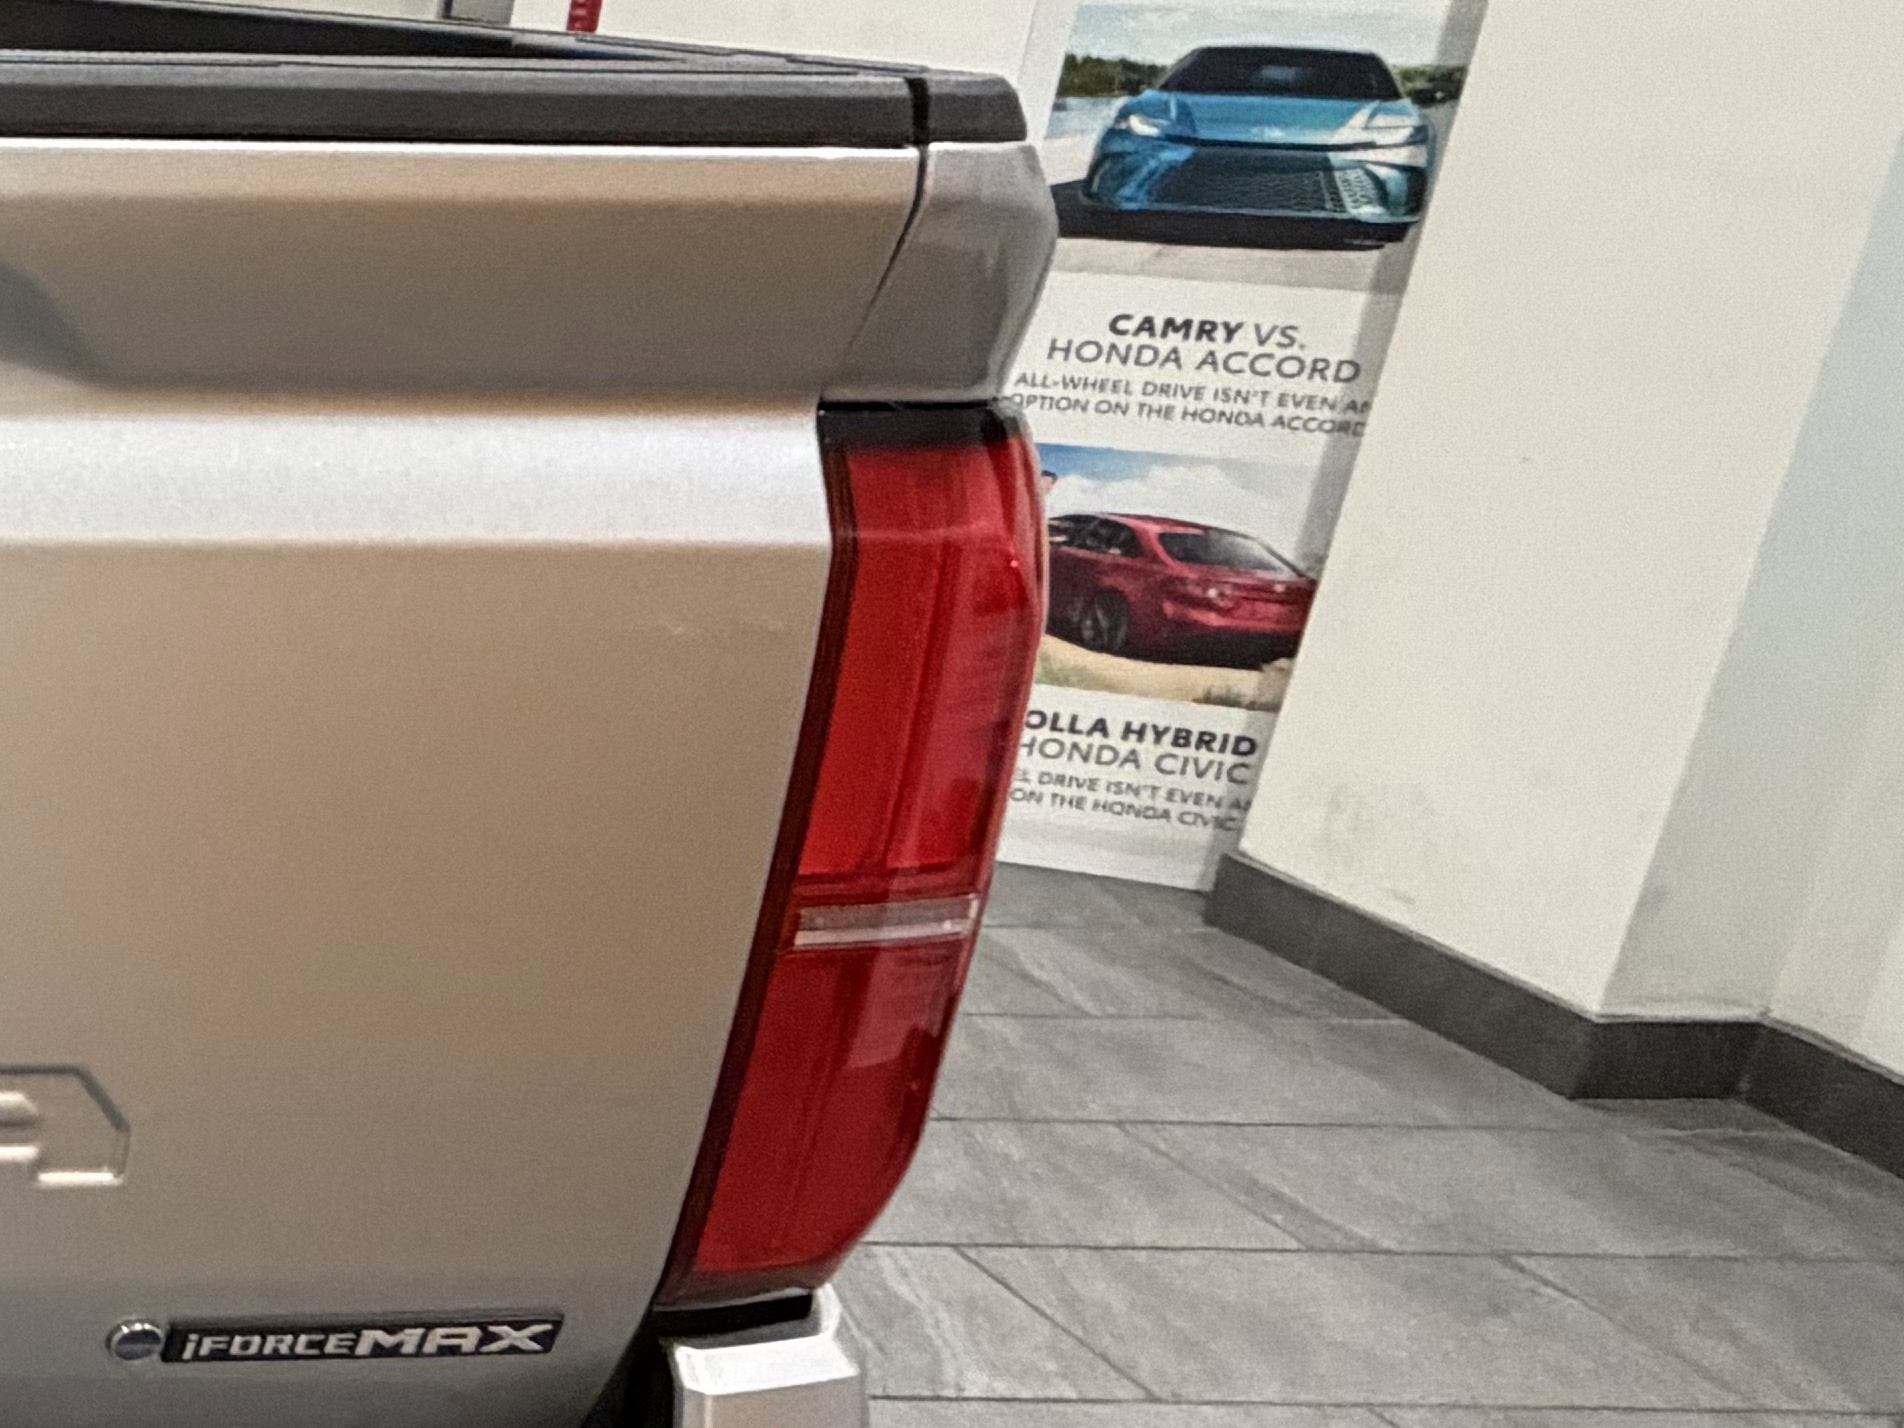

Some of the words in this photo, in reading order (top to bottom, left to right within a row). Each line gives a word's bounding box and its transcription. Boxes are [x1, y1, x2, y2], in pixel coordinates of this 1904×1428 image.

[1109, 313, 1243, 344] CAMRY
[1253, 323, 1307, 351] VS.
[1047, 337, 1182, 371] HONDA
[1195, 350, 1361, 384] ACCORD
[1014, 372, 1133, 396] ALL-WHEEL
[1142, 380, 1206, 401] DRIVE
[1213, 387, 1270, 407] ISN'T
[1277, 392, 1338, 412] EVEN
[1095, 399, 1130, 417] ON
[1137, 402, 1175, 421] THE
[1182, 407, 1265, 428] HONDA
[1120, 720, 1258, 757] HYBRID
[1154, 753, 1251, 786] CIVIC
[1009, 787, 1043, 804] ON
[1050, 792, 1088, 810] THE
[1092, 798, 1171, 821] HONDA
[1037, 771, 1101, 792] DRIVE
[1166, 787, 1223, 809] EVEN
